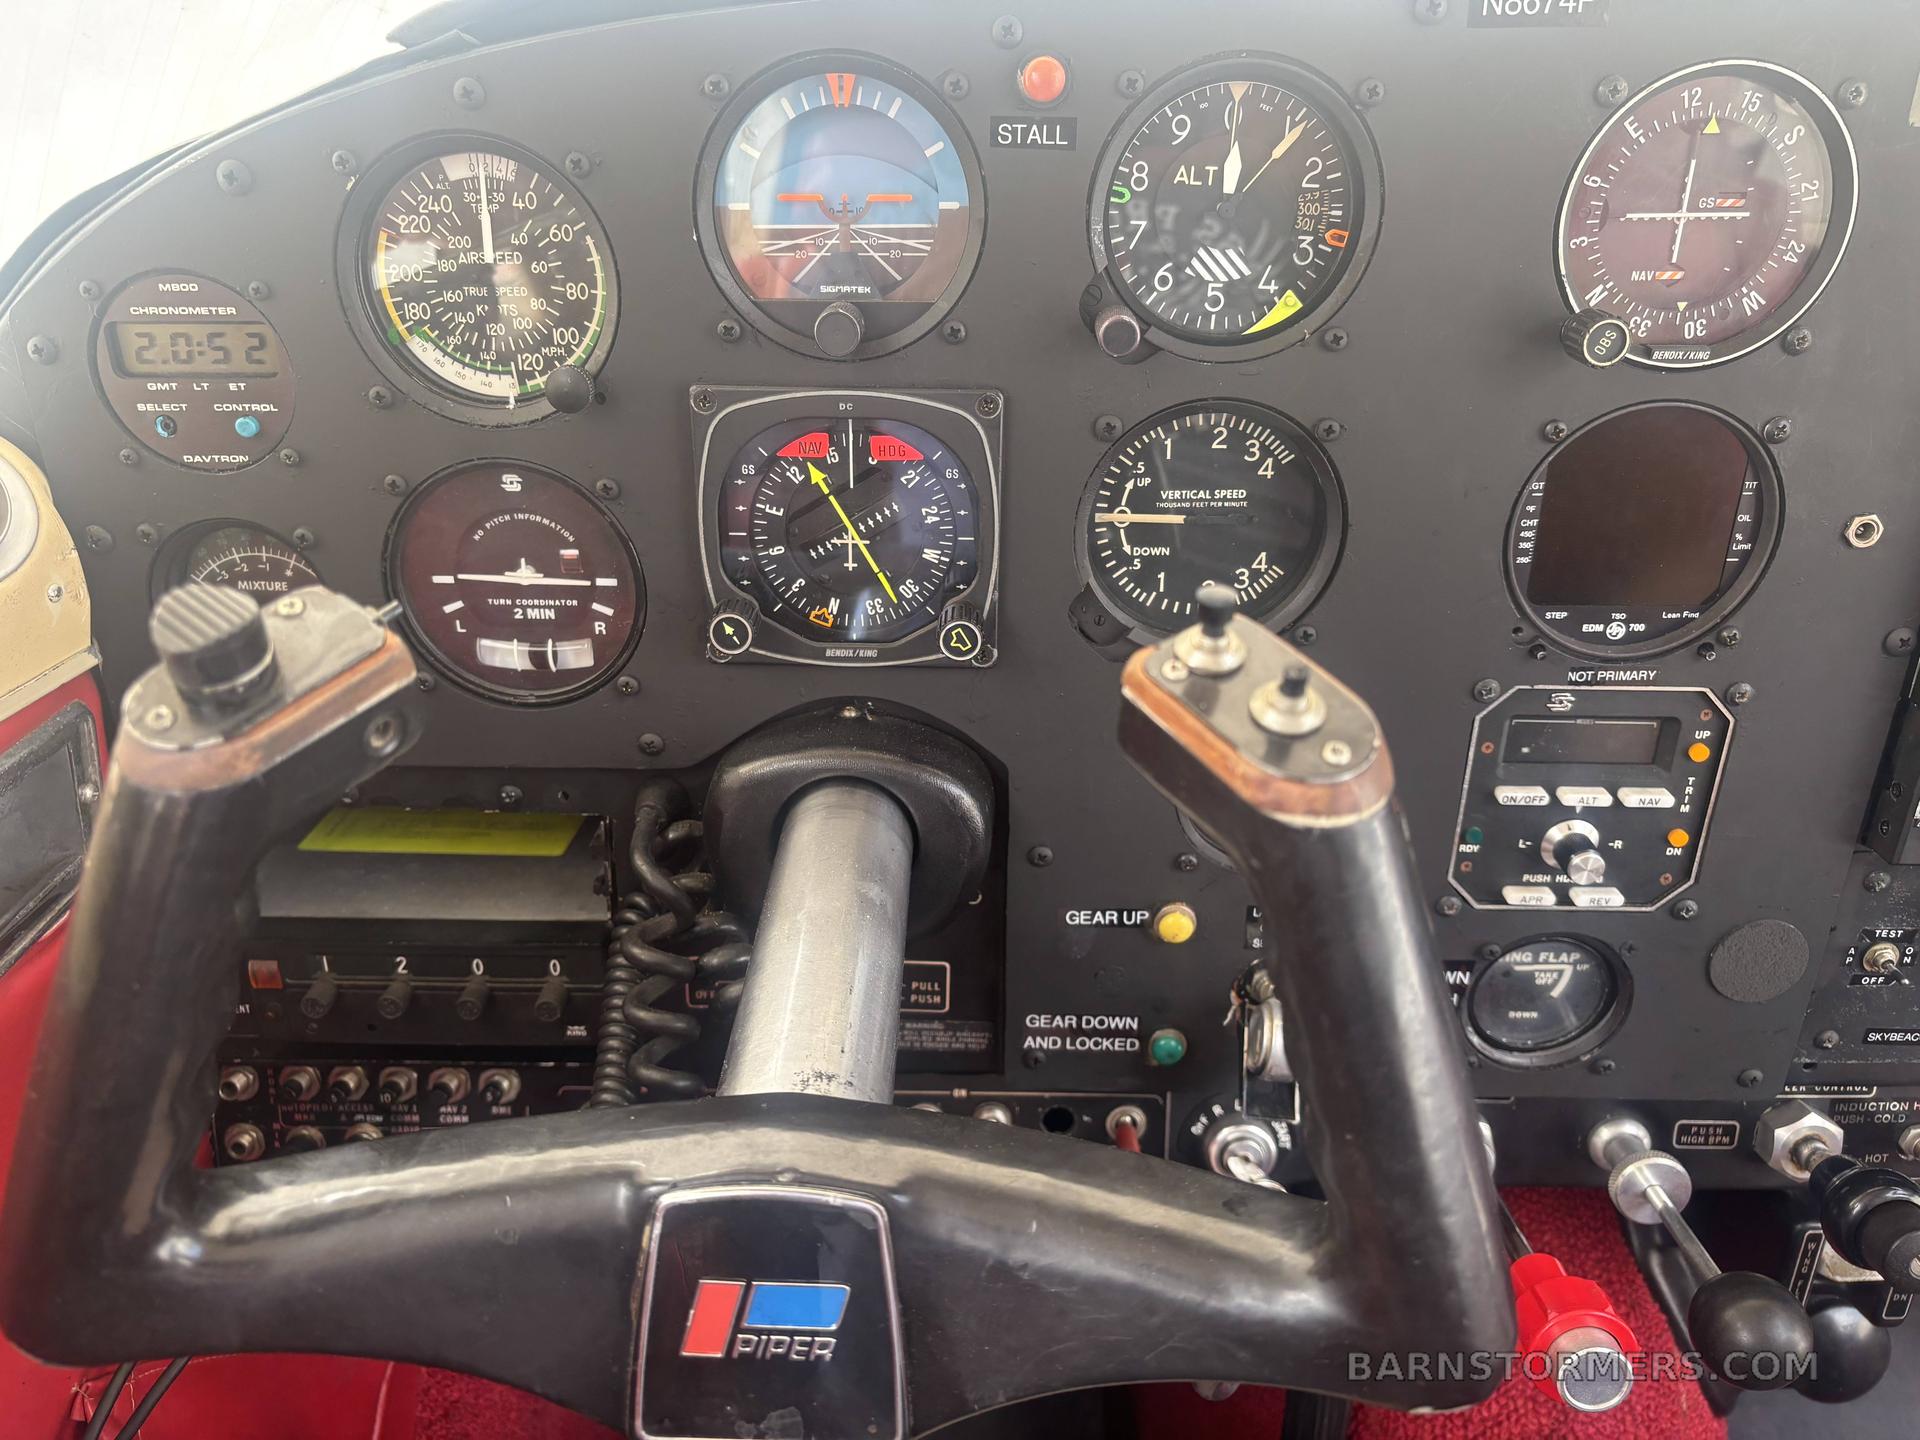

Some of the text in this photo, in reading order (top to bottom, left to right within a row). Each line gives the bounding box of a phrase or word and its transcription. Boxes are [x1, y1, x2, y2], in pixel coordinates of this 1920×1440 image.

[1681, 87, 1702, 109] 12
[1742, 90, 1762, 112] 15
[1172, 114, 1191, 145] 9
[1624, 115, 1644, 140] E
[997, 123, 1069, 146] STALL
[1784, 124, 1806, 146] S
[1130, 160, 1149, 191] 8
[1173, 165, 1219, 186] ALT
[1301, 157, 1323, 189] 2
[1801, 179, 1819, 201] 21
[418, 195, 452, 213] 240
[512, 192, 537, 209] 40
[1698, 197, 1715, 209] GS
[399, 215, 431, 233] 220
[511, 233, 528, 245] 40
[550, 224, 572, 242] 60
[1129, 220, 1147, 250] 7
[448, 237, 471, 249] 200
[794, 250, 808, 259] 20
[1293, 235, 1314, 266] 3
[1782, 242, 1806, 263] 24
[459, 252, 522, 264] AIRSEED
[437, 260, 456, 272] 180
[531, 261, 548, 273] 60
[390, 264, 422, 282] 200
[1154, 262, 1173, 291] 6
[1631, 271, 1654, 282] NAV
[1258, 265, 1279, 294] 4
[443, 290, 463, 302] 160
[463, 287, 527, 296] TRUE SPEED
[566, 283, 588, 300] 80
[1204, 283, 1225, 312] 5
[1585, 284, 1609, 307] N
[530, 299, 546, 310] 80
[1742, 290, 1766, 316] W
[130, 307, 237, 315] CHRONOMETER
[404, 303, 430, 320] 180
[454, 312, 475, 323] 140
[513, 318, 532, 329] 100
[486, 324, 505, 335] 120
[1684, 319, 1707, 339] 30
[447, 336, 461, 344] 160
[553, 328, 579, 345] 100
[1594, 329, 1617, 355] OBS
[480, 352, 496, 360] 140
[1652, 350, 1711, 360] BENDIX/KING
[519, 353, 543, 371] 120
[147, 383, 247, 391] GMT LT ET
[137, 404, 278, 412] SELECT CONTROL
[1211, 427, 1228, 449] 2
[798, 442, 822, 455] NAV
[878, 444, 906, 457] HDG
[1164, 438, 1171, 460] 1
[1244, 439, 1260, 462] 3
[183, 455, 249, 463] DAVTRON
[826, 447, 840, 464] 15
[742, 464, 755, 475] GS
[946, 469, 959, 479] GS
[1257, 457, 1275, 479] 4
[786, 466, 805, 484] 12
[900, 470, 920, 488] 21
[1137, 477, 1152, 487] UP
[1160, 489, 1247, 500] VERTICAL SPEED
[766, 506, 784, 516] E
[922, 506, 940, 524] 24
[473, 513, 576, 543] NO PITCH INFORMATION
[1520, 519, 1539, 527] CHT
[922, 548, 941, 564] W
[1133, 547, 1170, 556] DOWN
[1251, 551, 1268, 573] 4
[1157, 572, 1164, 593] 1
[1234, 568, 1249, 590] 3
[238, 581, 288, 591] MIXTURE
[898, 578, 920, 598] 30
[828, 598, 840, 617] N
[866, 598, 884, 615] 33
[514, 608, 555, 619] 2 MIN
[1545, 611, 1568, 620] STEP
[1662, 611, 1700, 619] Lean Find
[456, 620, 466, 632] L
[594, 621, 607, 634] R
[1582, 624, 1645, 632] EDM 700
[825, 648, 878, 658] BENDIX/KING
[1567, 670, 1657, 682] NOT PRIMARY
[1695, 730, 1711, 739] UP
[1501, 795, 1545, 804] ON/OFF
[1680, 776, 1696, 813] TRIM
[1577, 797, 1598, 805] ALT
[1638, 797, 1662, 806] NAV
[1458, 844, 1480, 853] RDY
[1666, 847, 1682, 856] DN
[1522, 874, 1551, 883] PUSH
[1520, 896, 1543, 904] APR
[1589, 897, 1611, 905] REV
[1065, 910, 1149, 925] GEAR UP
[1875, 930, 1903, 938] TEST
[1500, 952, 1581, 963] ING FLAP
[395, 957, 408, 974] 2
[471, 958, 484, 976] 0
[550, 959, 561, 976] 0
[1534, 971, 1559, 979] TAKE
[912, 981, 940, 991] PULL
[910, 994, 941, 1003] PUSH
[1025, 1015, 1138, 1030] GEAR DOWN
[1024, 1036, 1140, 1052] AND LOCKED
[1835, 1102, 1909, 1112] INDUCTION
[1833, 1114, 1906, 1124] PUSH COLD
[1692, 1126, 1723, 1134] PUSH
[1865, 1154, 1889, 1163] HOT
[732, 1333, 837, 1362] PIPER
